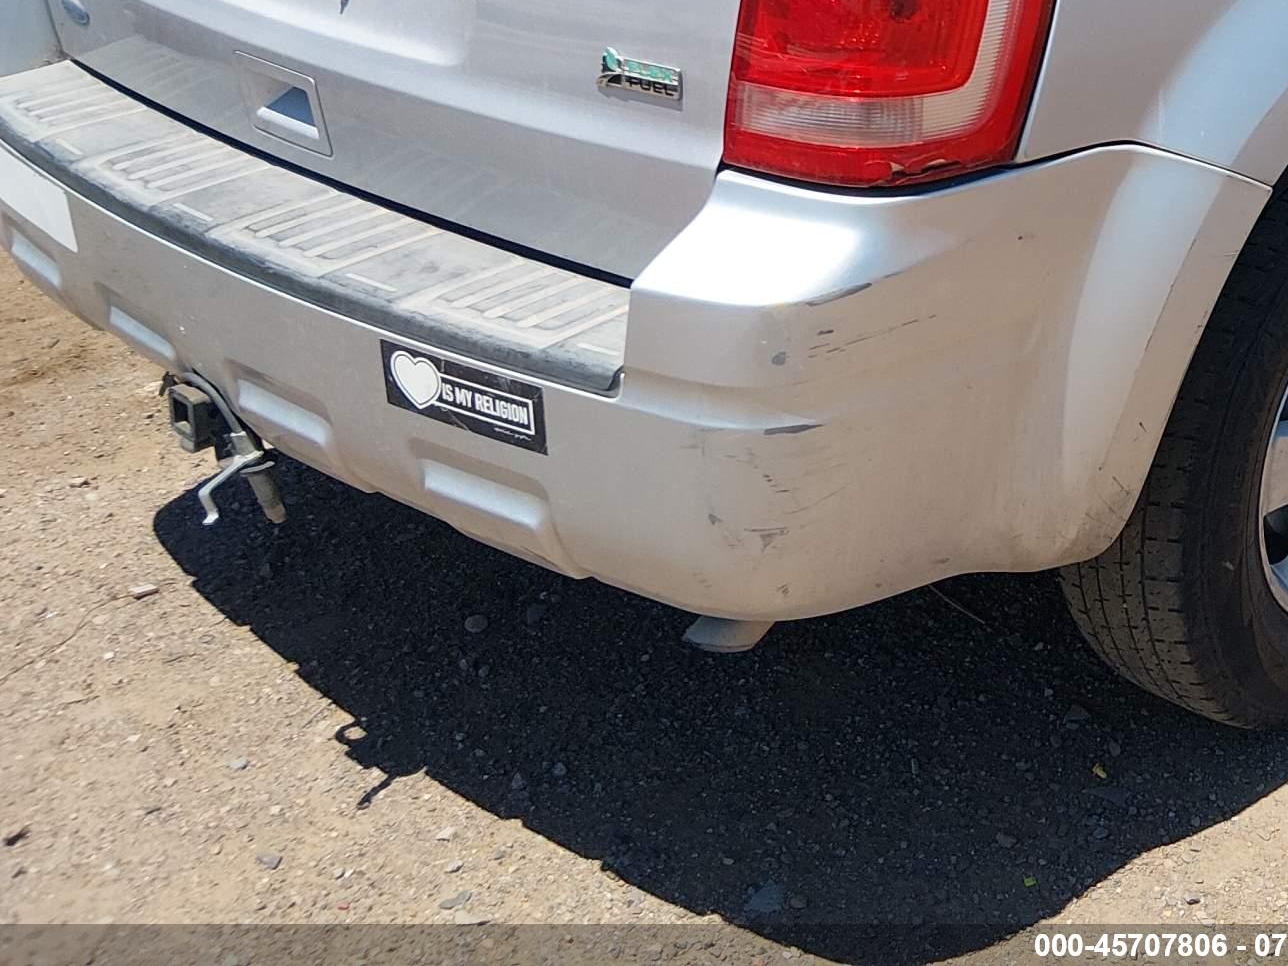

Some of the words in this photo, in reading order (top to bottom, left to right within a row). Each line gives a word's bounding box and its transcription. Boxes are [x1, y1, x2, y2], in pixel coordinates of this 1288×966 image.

[441, 382, 454, 402] IS
[454, 387, 473, 408] MY
[474, 392, 529, 425] RELIGION
